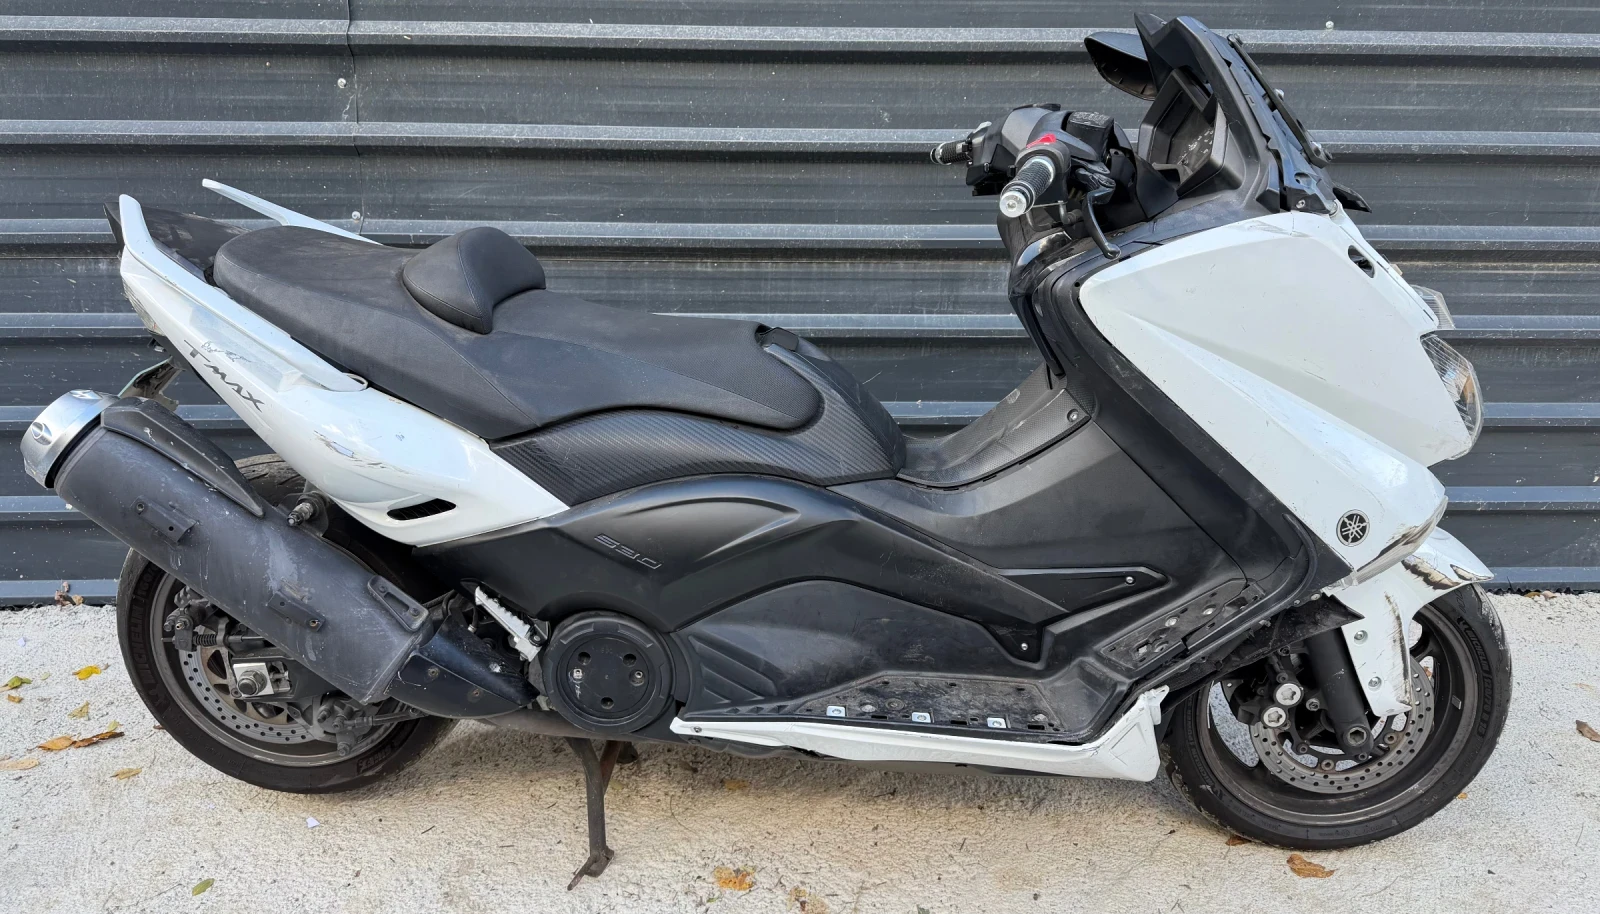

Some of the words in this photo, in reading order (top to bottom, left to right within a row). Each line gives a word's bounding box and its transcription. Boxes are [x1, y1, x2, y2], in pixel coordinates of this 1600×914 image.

[594, 533, 662, 569] 530
[131, 606, 154, 684] MICHELIN
[1465, 628, 1490, 672] MICHELIN
